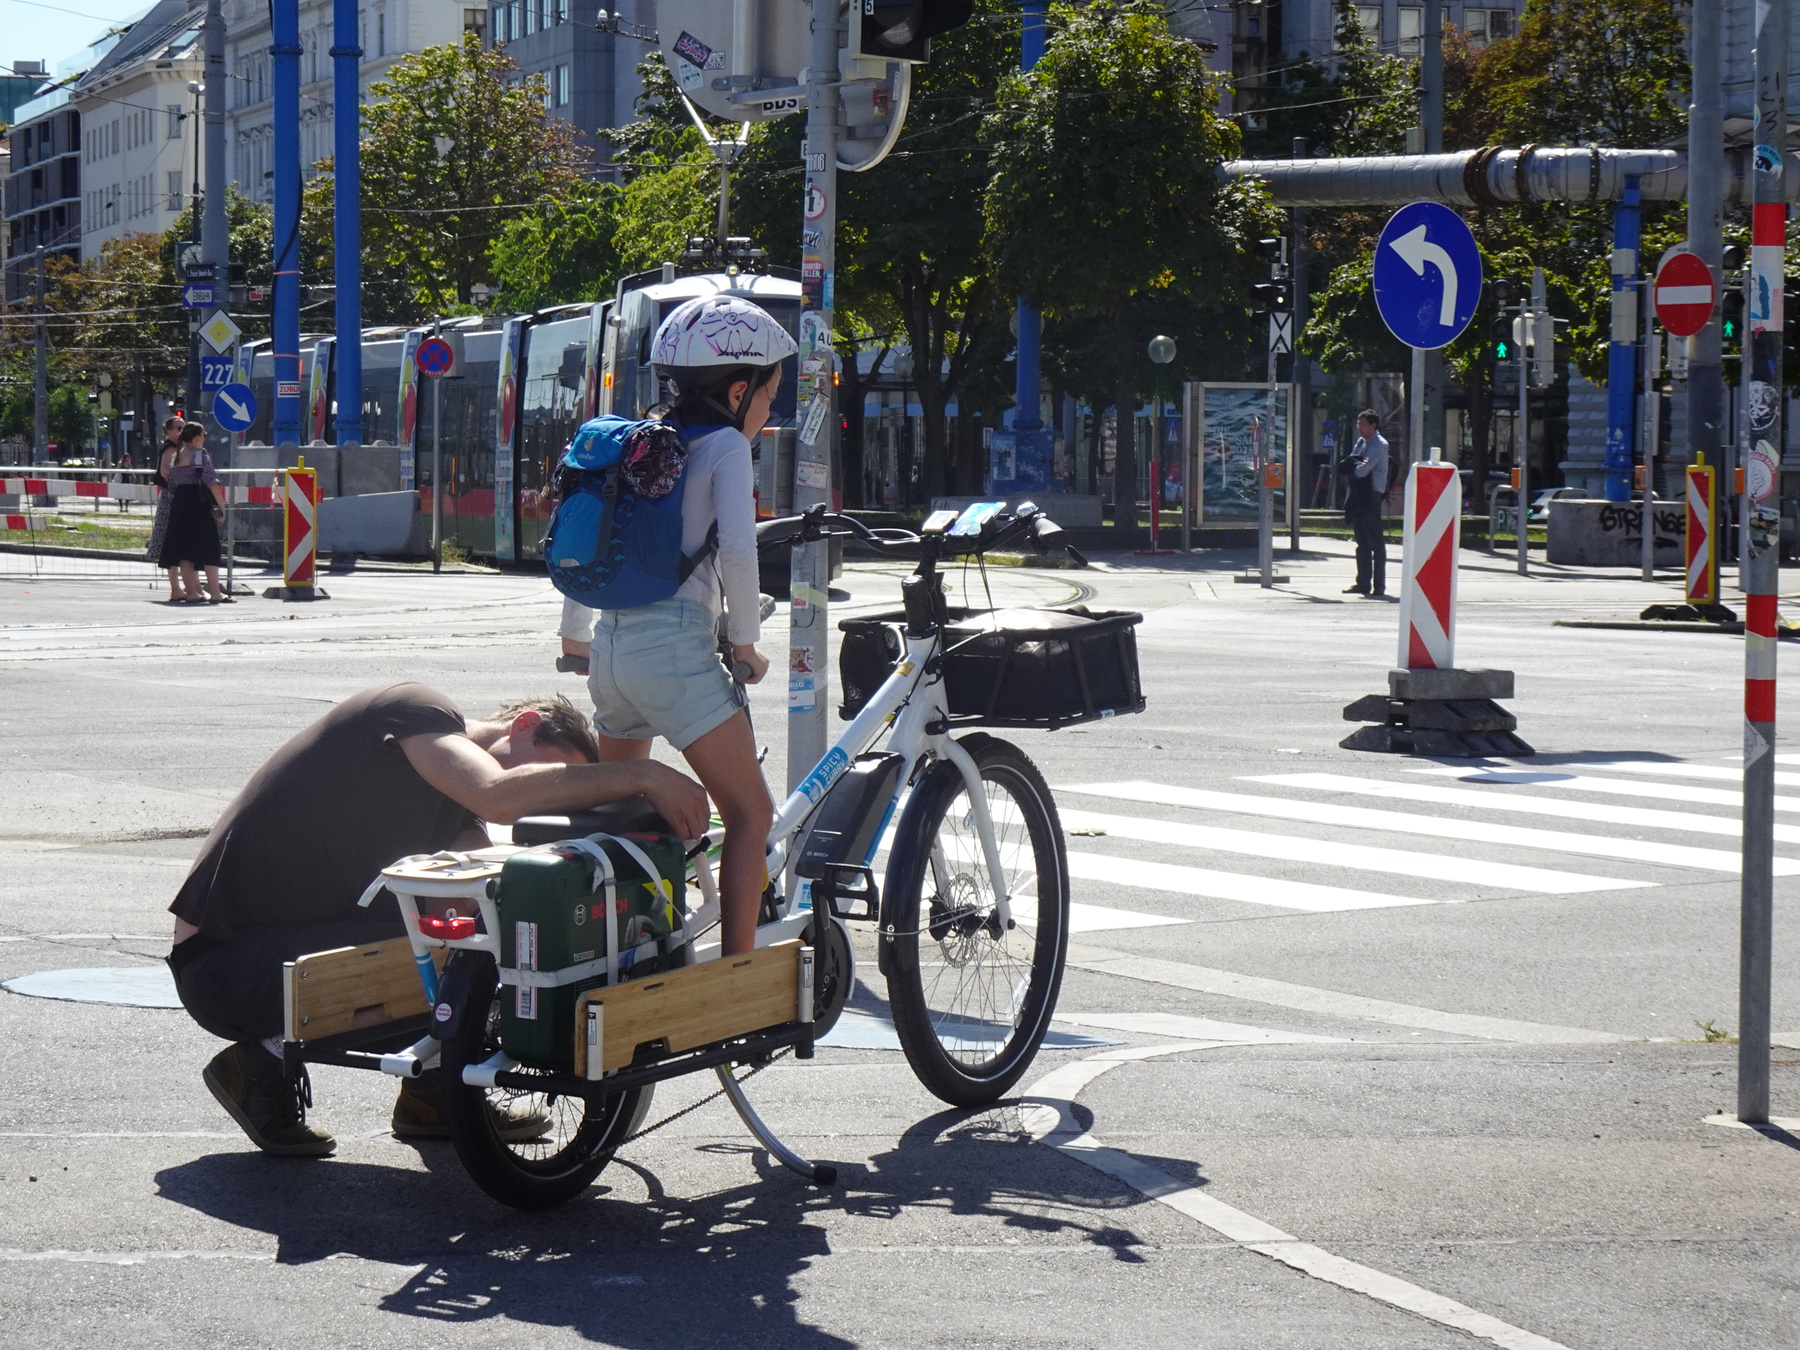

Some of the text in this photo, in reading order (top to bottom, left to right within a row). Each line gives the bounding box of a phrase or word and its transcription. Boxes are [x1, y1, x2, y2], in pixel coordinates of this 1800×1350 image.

[204, 363, 235, 385] 227
[818, 752, 841, 778] SPICY
[825, 758, 845, 785] CURRY
[592, 898, 628, 920] BOCH
